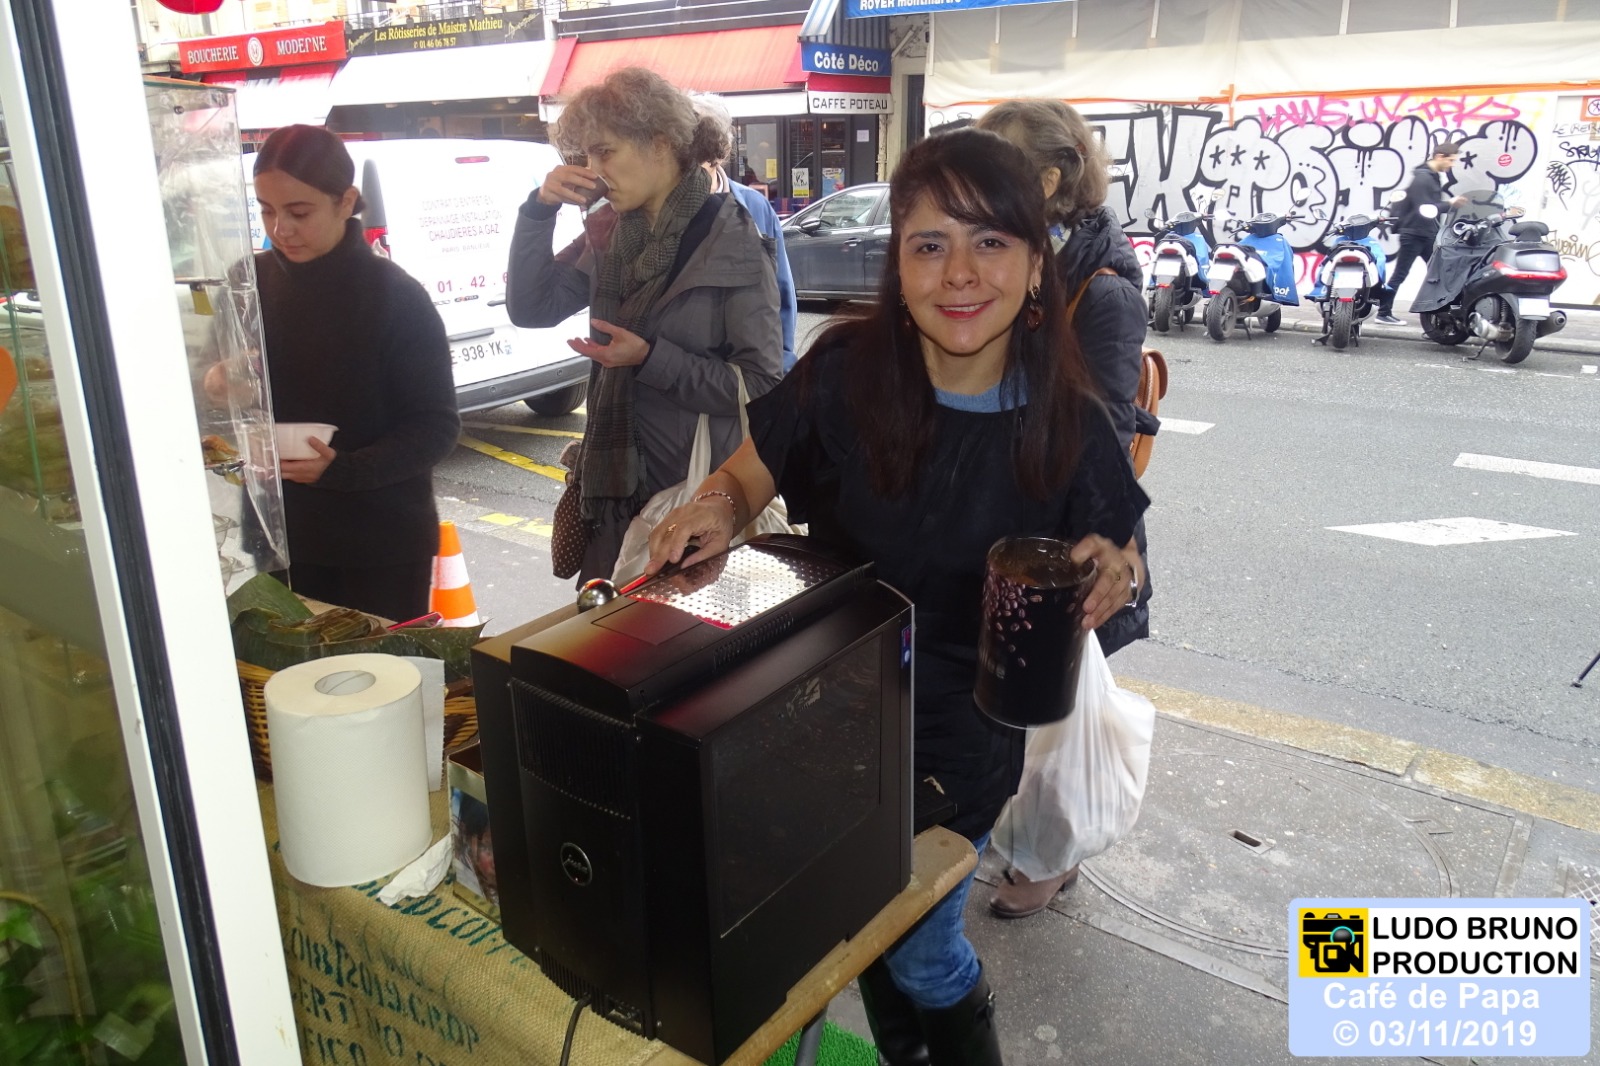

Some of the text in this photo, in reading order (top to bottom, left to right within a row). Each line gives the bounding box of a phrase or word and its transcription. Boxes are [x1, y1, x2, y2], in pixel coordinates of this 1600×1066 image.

[374, 29, 387, 42] Les
[388, 25, 426, 40] Rôtisseries
[427, 23, 437, 36] de
[438, 21, 467, 35] Maistre
[468, 17, 503, 33] Mathieu
[419, 39, 426, 49] 01
[426, 39, 434, 48] 46
[187, 45, 239, 65] BOUCHERIE
[814, 50, 879, 72] Côté Déco
[812, 96, 888, 110] CAFFE POTEAU
[428, 226, 478, 242] CHAUDIERES
[484, 223, 500, 235] GAZ
[450, 340, 504, 366] E-938-YK
